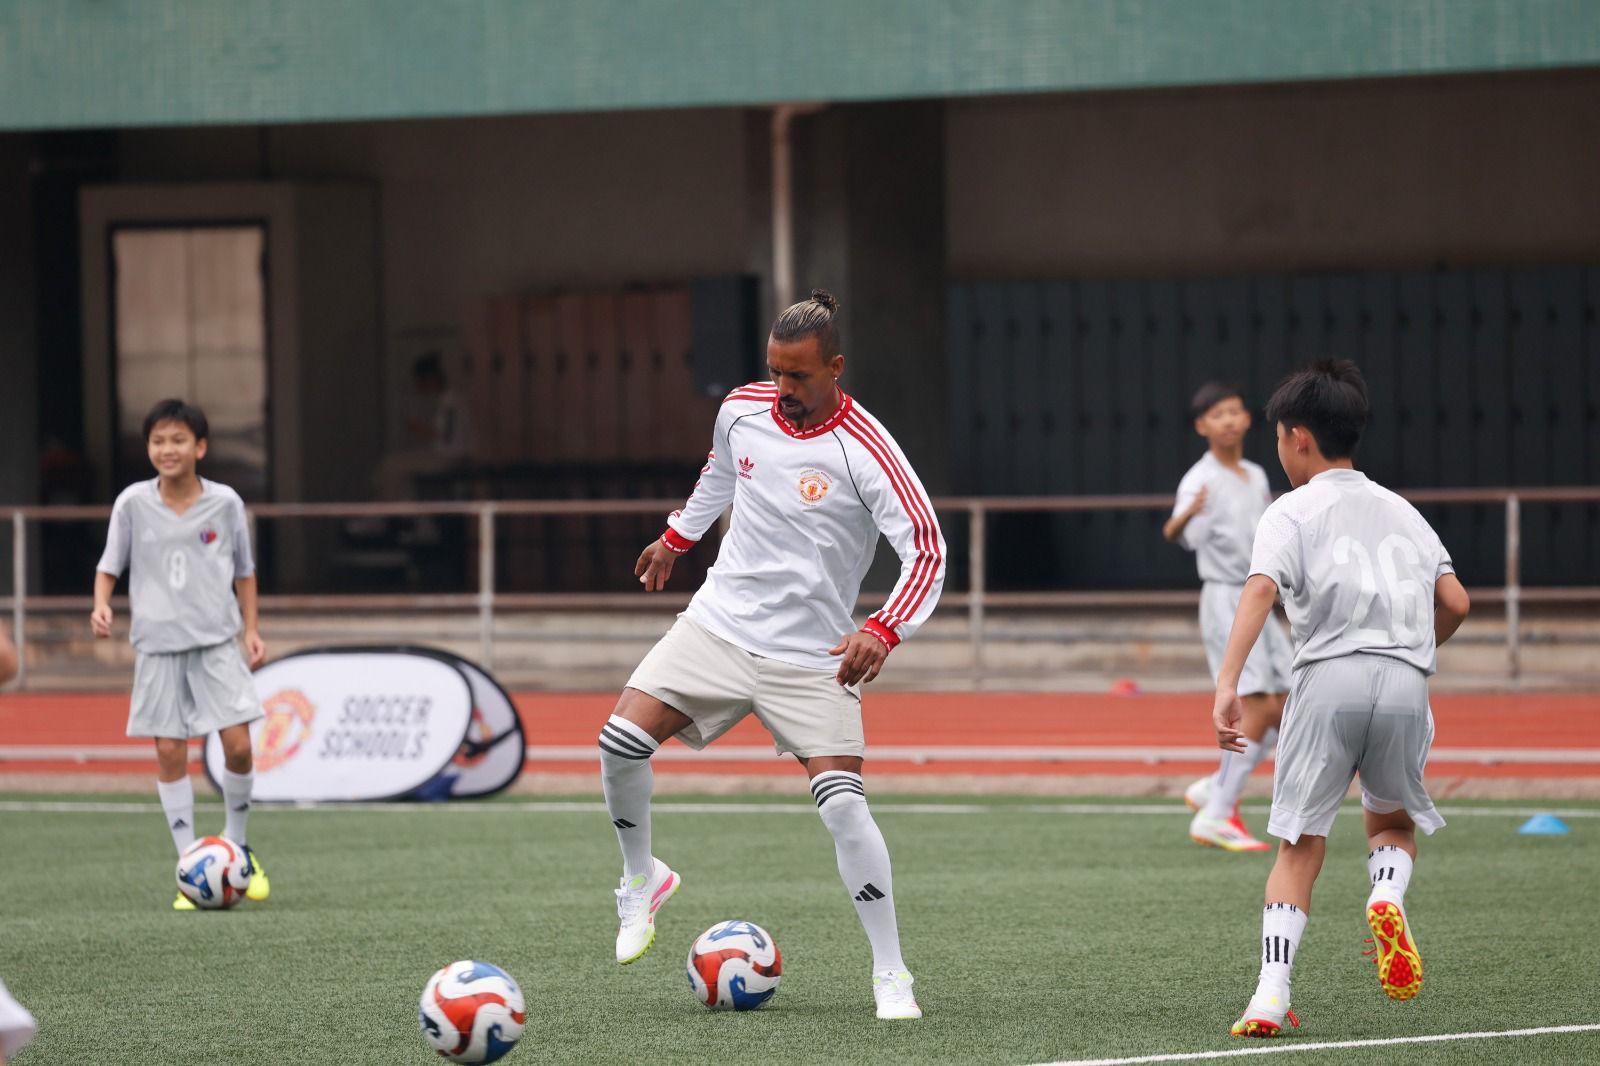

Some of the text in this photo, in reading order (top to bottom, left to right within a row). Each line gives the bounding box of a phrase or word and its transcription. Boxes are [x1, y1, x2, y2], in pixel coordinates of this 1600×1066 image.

[168, 549, 187, 590] 8
[1332, 533, 1429, 648] 26
[339, 695, 433, 725] SOCCER
[318, 730, 428, 760] SCHOOLS
